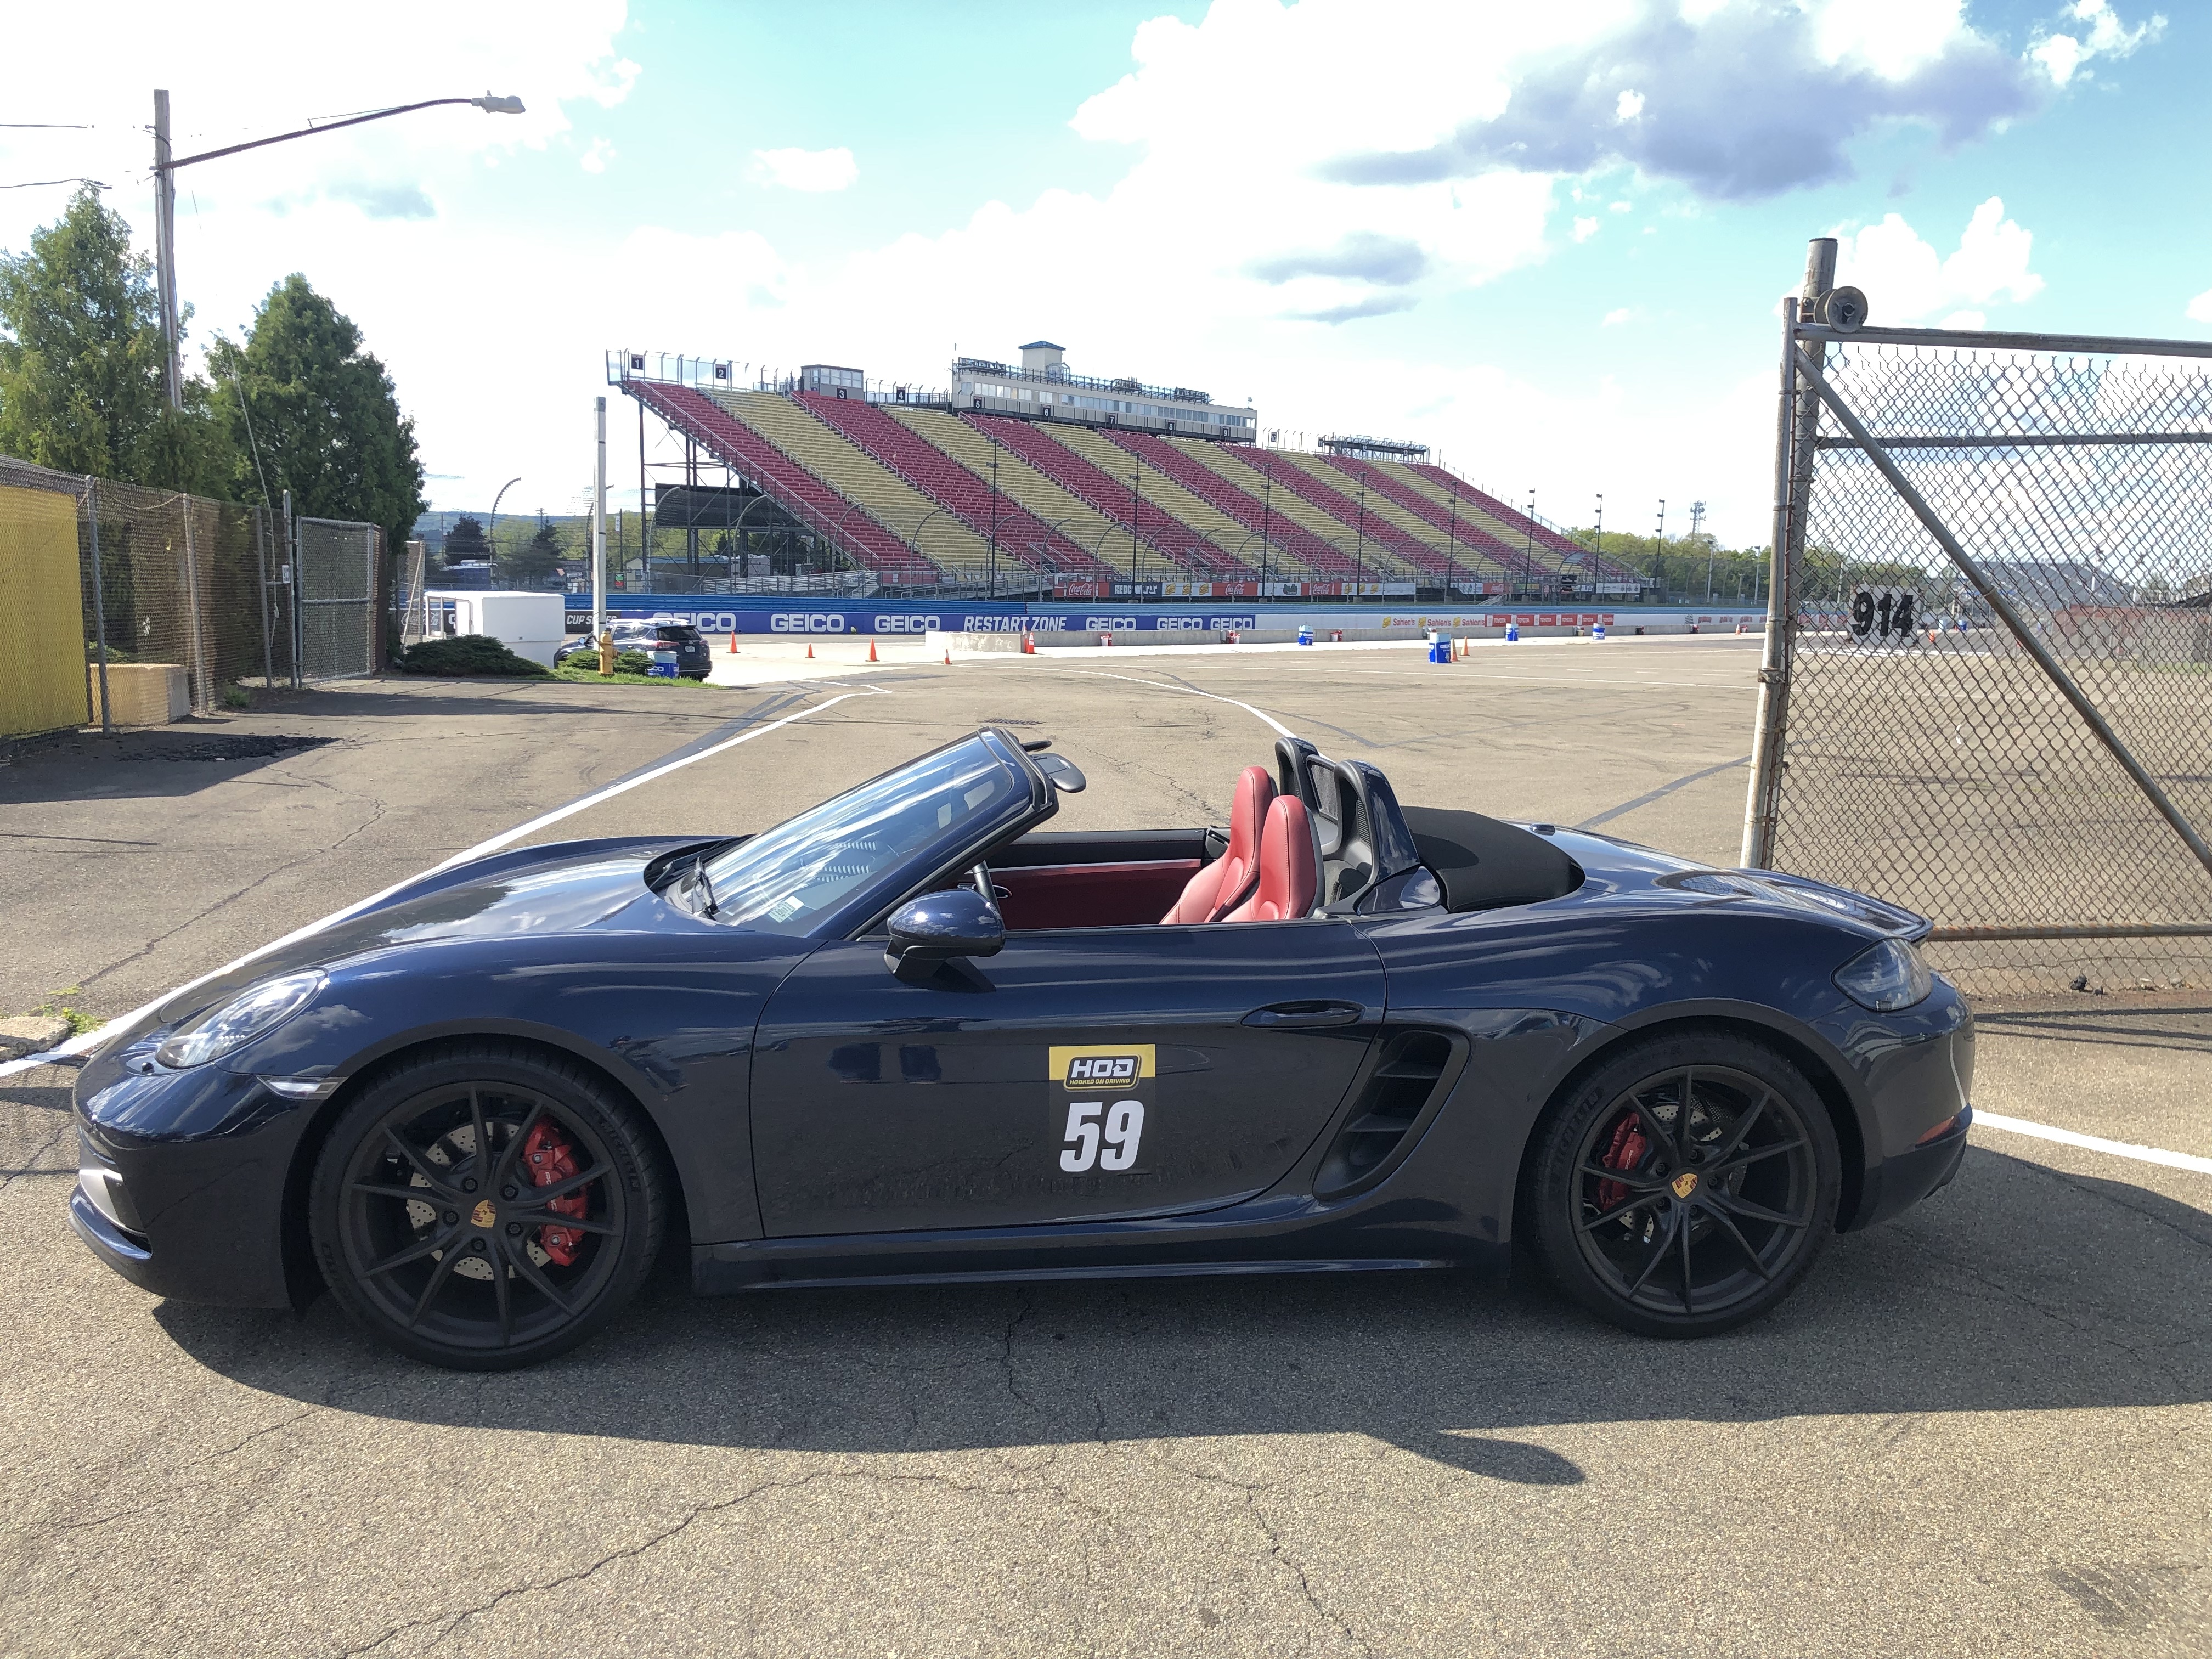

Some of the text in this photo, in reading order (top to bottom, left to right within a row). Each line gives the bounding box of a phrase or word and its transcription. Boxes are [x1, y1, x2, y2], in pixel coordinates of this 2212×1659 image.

[635, 359, 640, 369] 1
[718, 369, 724, 379] 2
[839, 390, 845, 399] 3
[898, 391, 904, 399] 4
[1044, 408, 1049, 416] 6
[1114, 584, 1142, 594] REDCM
[566, 614, 585, 625] CUP
[1852, 591, 1914, 637] 914
[770, 613, 844, 632] GEICO
[874, 615, 940, 633] GEICO
[963, 616, 1067, 631] RESTART ZONE
[1086, 617, 1136, 631] GEICO
[1156, 617, 1253, 630] GEICO GEICO
[1392, 618, 1415, 627] Sahlen's
[1462, 618, 1485, 627] Sahlen's
[1070, 1059, 1135, 1079] HOD
[1059, 1100, 1144, 1172] 59
